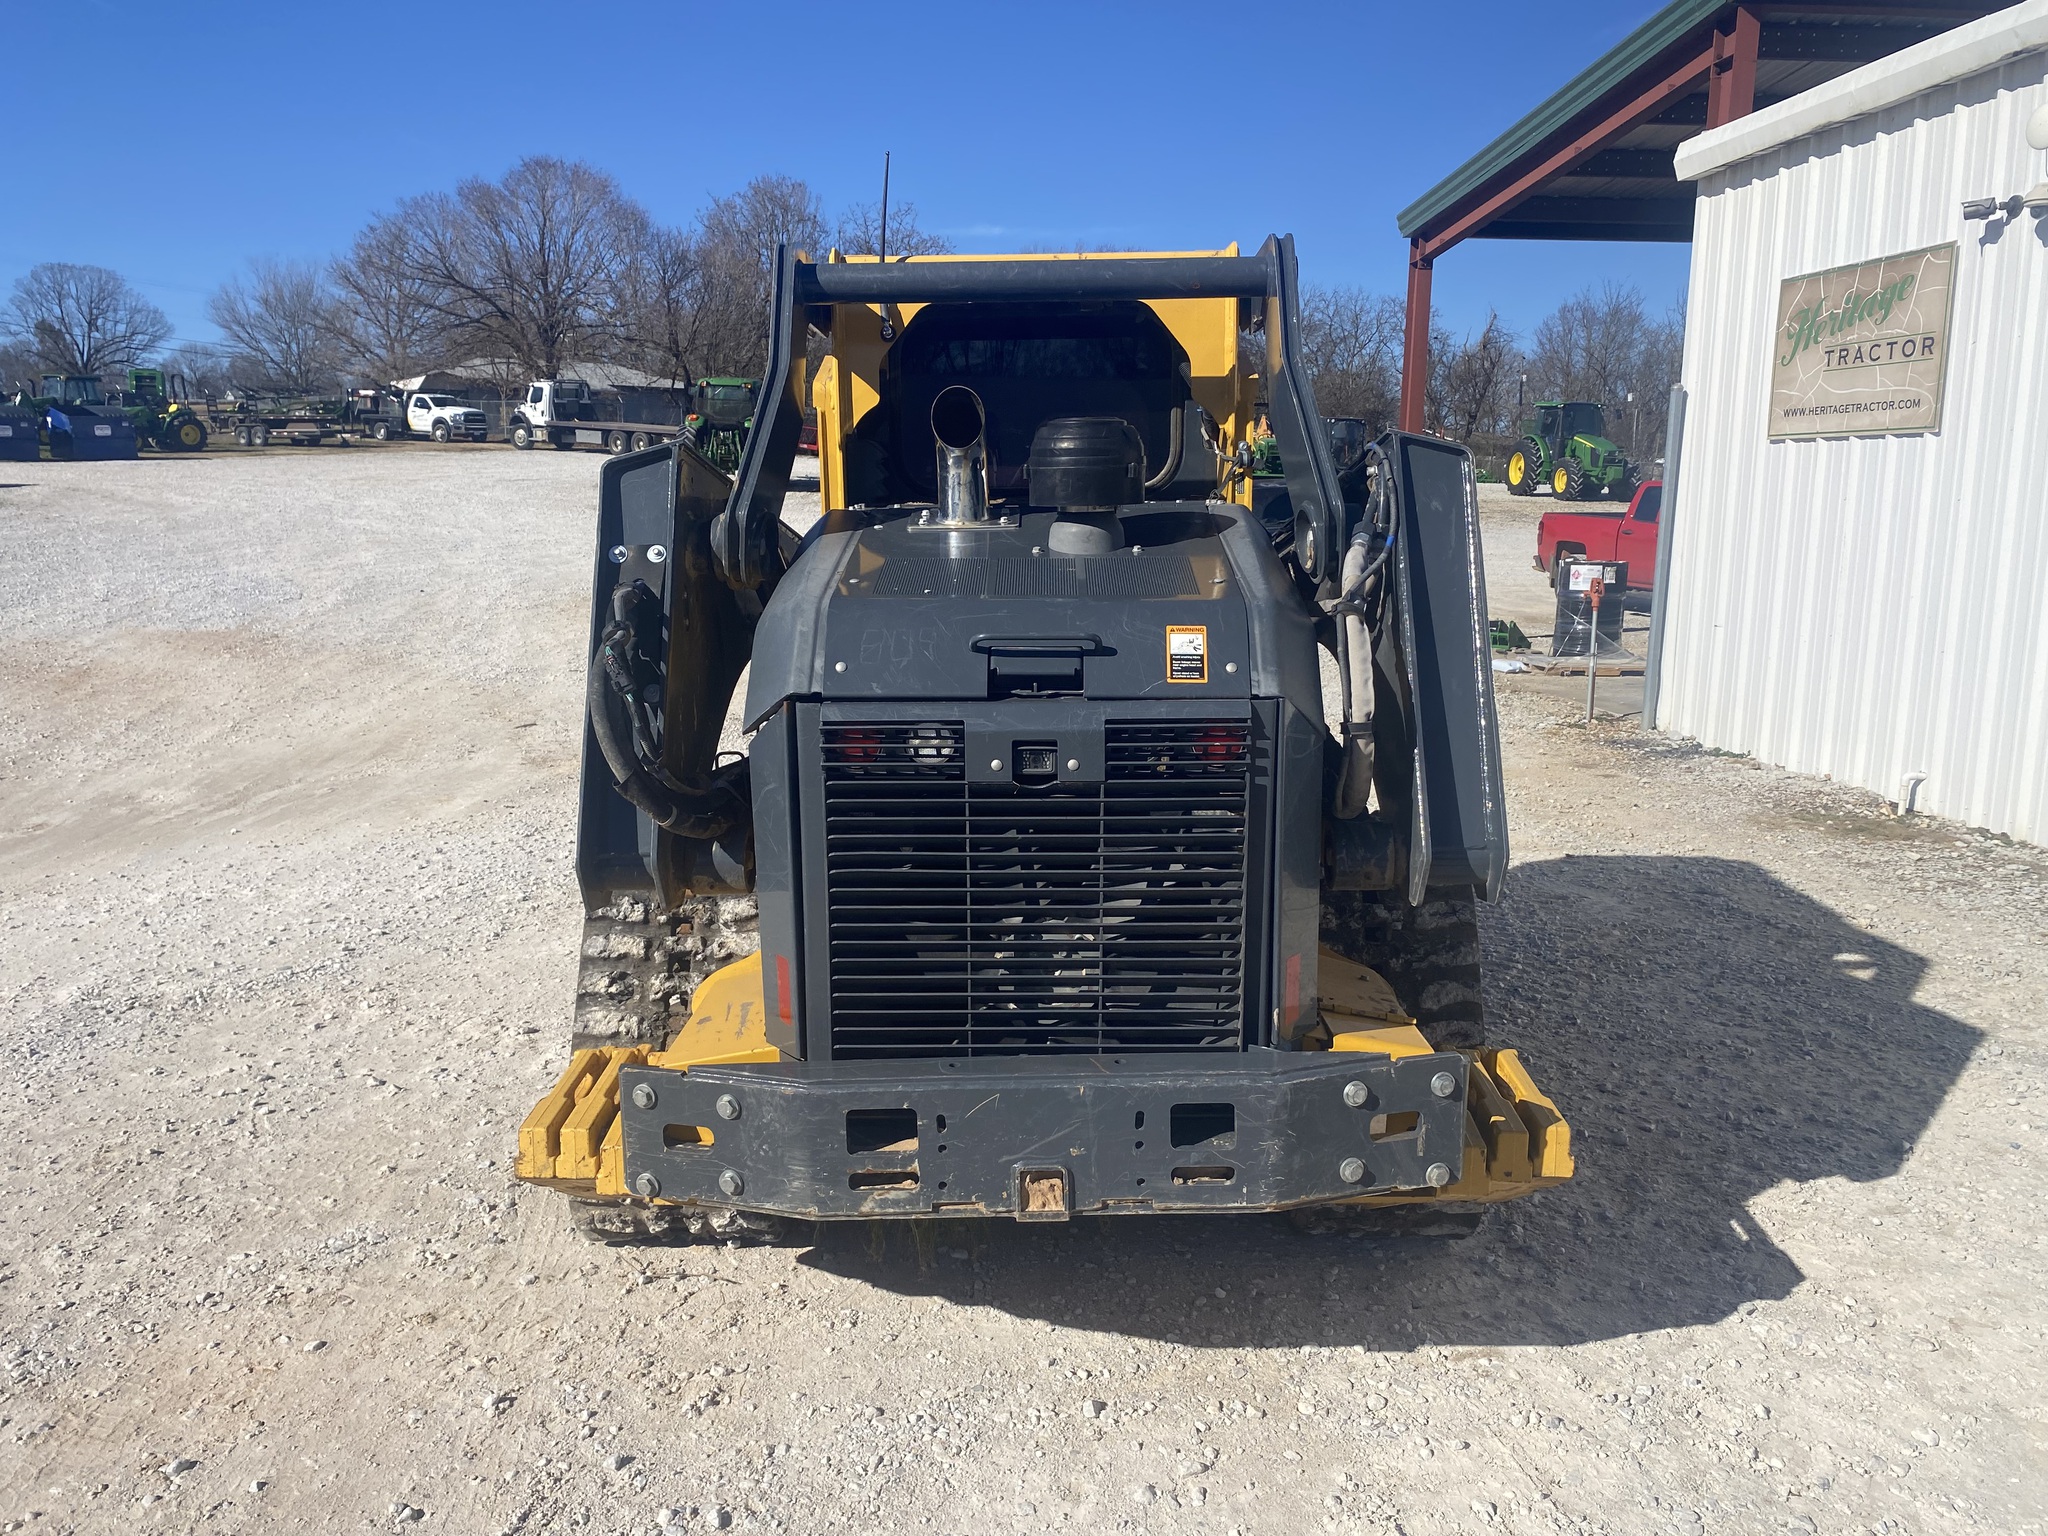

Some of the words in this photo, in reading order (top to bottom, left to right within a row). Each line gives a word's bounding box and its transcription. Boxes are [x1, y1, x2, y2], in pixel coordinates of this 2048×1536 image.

[1781, 274, 1915, 367] Heritage
[1825, 336, 1935, 367] TRACTOR
[1783, 398, 1921, 418] WWW.HERITAGETRACTOR.COM
